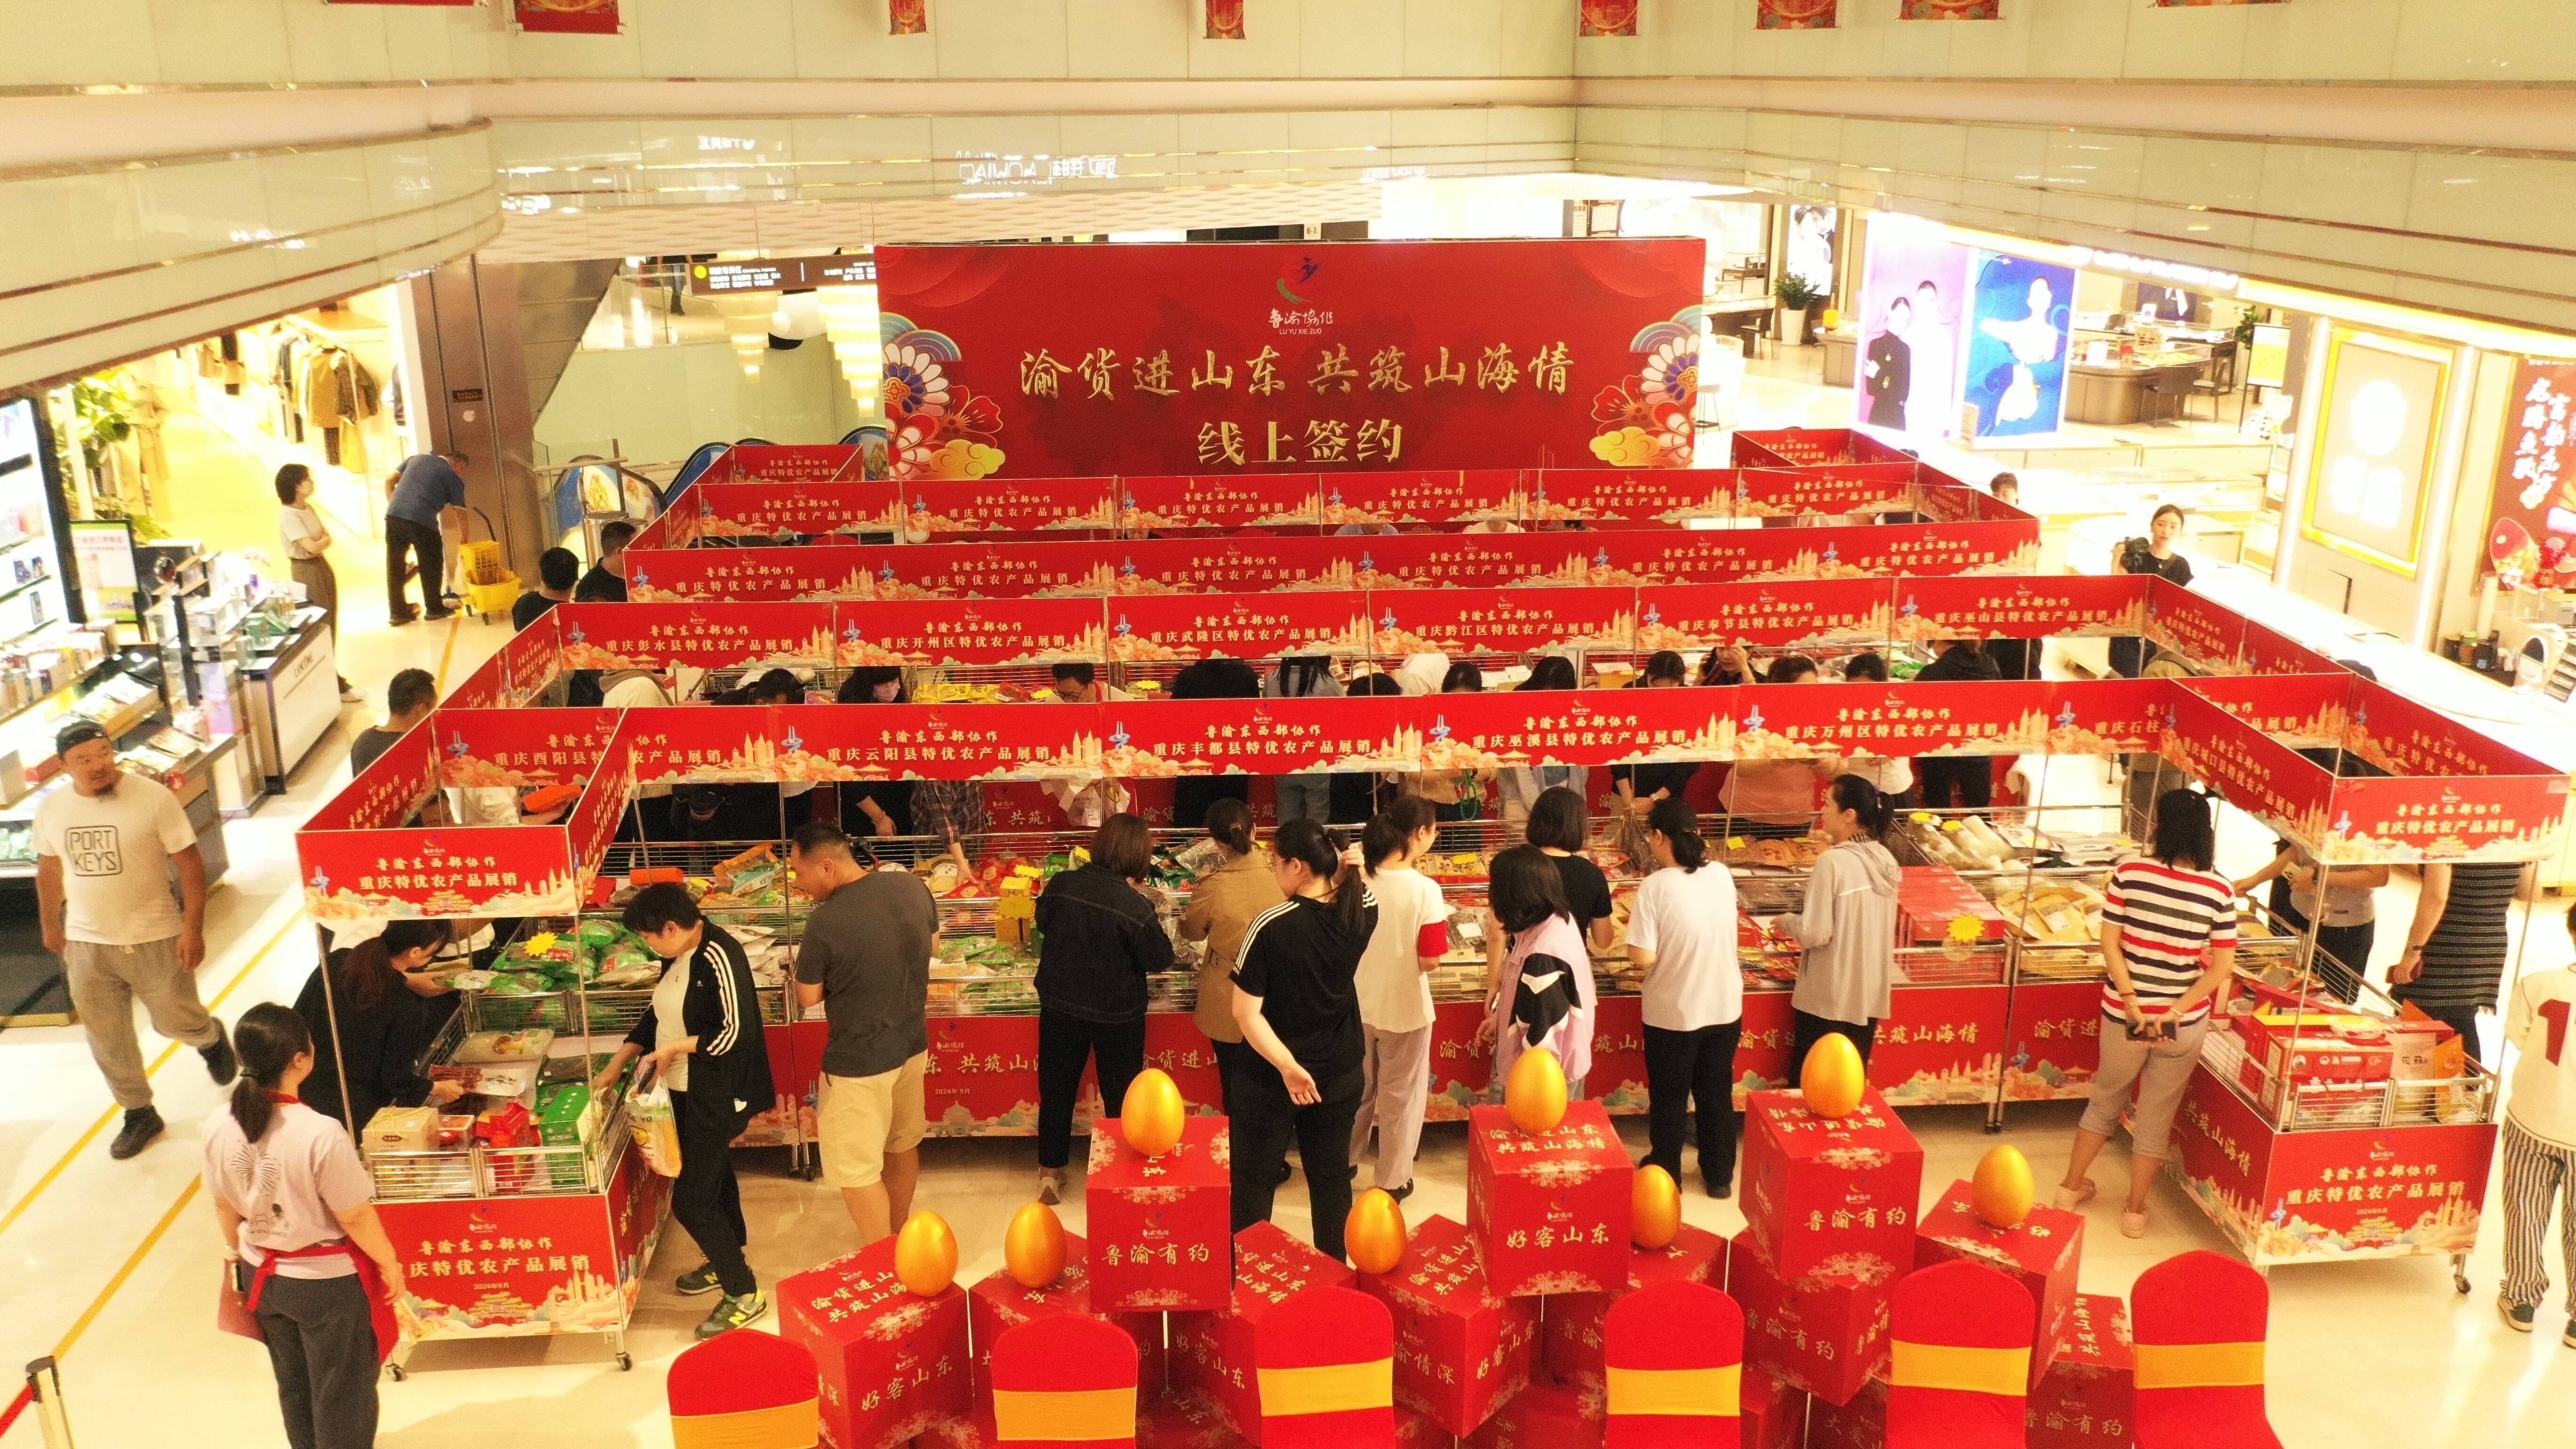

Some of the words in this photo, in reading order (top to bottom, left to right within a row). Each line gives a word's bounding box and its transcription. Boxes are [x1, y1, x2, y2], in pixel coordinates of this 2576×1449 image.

[1020, 345, 1285, 400] 渝货进山东
[1307, 341, 1574, 395] 共筑山海情
[1197, 419, 1403, 466] 线上签约
[1183, 491, 1258, 502] 鲁渝东西部协作
[1389, 484, 1463, 498] 鲁渝东西部协作
[1593, 485, 1667, 495] 鲁渝东西部协作
[763, 499, 840, 510] 鲁渝东西部协作
[974, 495, 1050, 506] 鲁渝东西部协作
[1362, 498, 1490, 513] 重庆特优农产品展销
[1564, 496, 1693, 509] 重庆特优农产品展销
[737, 510, 869, 523] 重庆特优农产品展销
[949, 506, 1079, 520] 重庆特优农产品展销
[1158, 502, 1286, 516] 重庆特优农产品展销
[1662, 545, 1746, 559] 鲁渝东西部协作
[1889, 538, 1969, 553] 鲁渝东西部协作
[1191, 555, 1277, 568] 鲁渝东西部协作
[1428, 551, 1513, 563] 鲁渝东西部协作
[1861, 550, 1996, 568] 重庆特优农产品展销
[705, 565, 794, 578] 鲁渝东西部协作
[950, 560, 1038, 572] 鲁渝东西部协作
[1399, 564, 1544, 580] 重庆特优农产品展销
[1633, 559, 1775, 574] 重庆特优农产品展销
[921, 572, 1070, 589] 重庆特优农产品展销
[1158, 568, 1308, 584] 重庆特优农产品展销
[676, 578, 828, 595] 重庆特优农产品展销
[1720, 601, 1813, 616] 鲁渝东西部协作
[1977, 595, 2069, 609] 鲁渝东西部协作
[1193, 612, 1289, 628] 鲁渝东西部协作
[1458, 609, 1553, 622] 鲁渝东西部协作
[1675, 612, 1856, 635] 重庆奉节县特优农产品展销
[1932, 610, 2111, 626] 重庆巫山县特优农产品展销
[649, 624, 749, 637] 鲁渝东西部协作
[924, 619, 1022, 634] 鲁渝东西部协作
[1413, 622, 1596, 640] 重庆黔江区特优农产品展销
[1148, 625, 1334, 645] 重庆武隆区特优农产品展销
[604, 639, 796, 654] 重庆彭水县特优农产品展销
[878, 635, 1068, 652] 重庆开州区特优农产品展销
[1523, 713, 1637, 730] 鲁渝东西部协作
[1836, 706, 1950, 722] 鲁渝东西部协作
[879, 729, 998, 744] 鲁渝东西部协作
[1205, 722, 1320, 739] 鲁渝东西部协作
[1469, 727, 1688, 750] 重庆巫溪县特优农产品展销
[1782, 723, 2000, 741] 重庆万州区特优农产品展销
[824, 746, 1054, 764] 重庆云阳县特优农产品展销
[1150, 739, 1373, 759] 重庆丰都县特优农产品展销
[2396, 801, 2501, 817] 鲁渝东西部协作
[2377, 819, 2515, 837] 重庆特优农产品展销
[70, 830, 113, 851] PORT
[73, 852, 117, 872] KEYS
[376, 856, 496, 871] 鲁渝东西部协作
[359, 872, 517, 892] 重庆特优农产品展销
[1495, 1137, 1606, 1154] 共筑山海情
[2320, 1164, 2437, 1184] 鲁渝东西部协作
[2285, 1179, 2464, 1207] 重庆特优农产品展销
[1804, 1206, 1906, 1232] 鲁渝有约
[1506, 1223, 1609, 1248] 好客山东
[419, 1237, 552, 1256] 鲁渝东西部协作
[1102, 1243, 1209, 1266] 鲁渝有约
[1747, 1308, 1835, 1361] 鲁渝有约
[1476, 1320, 1534, 1380] 好客山东
[861, 1354, 953, 1411] 好客山东
